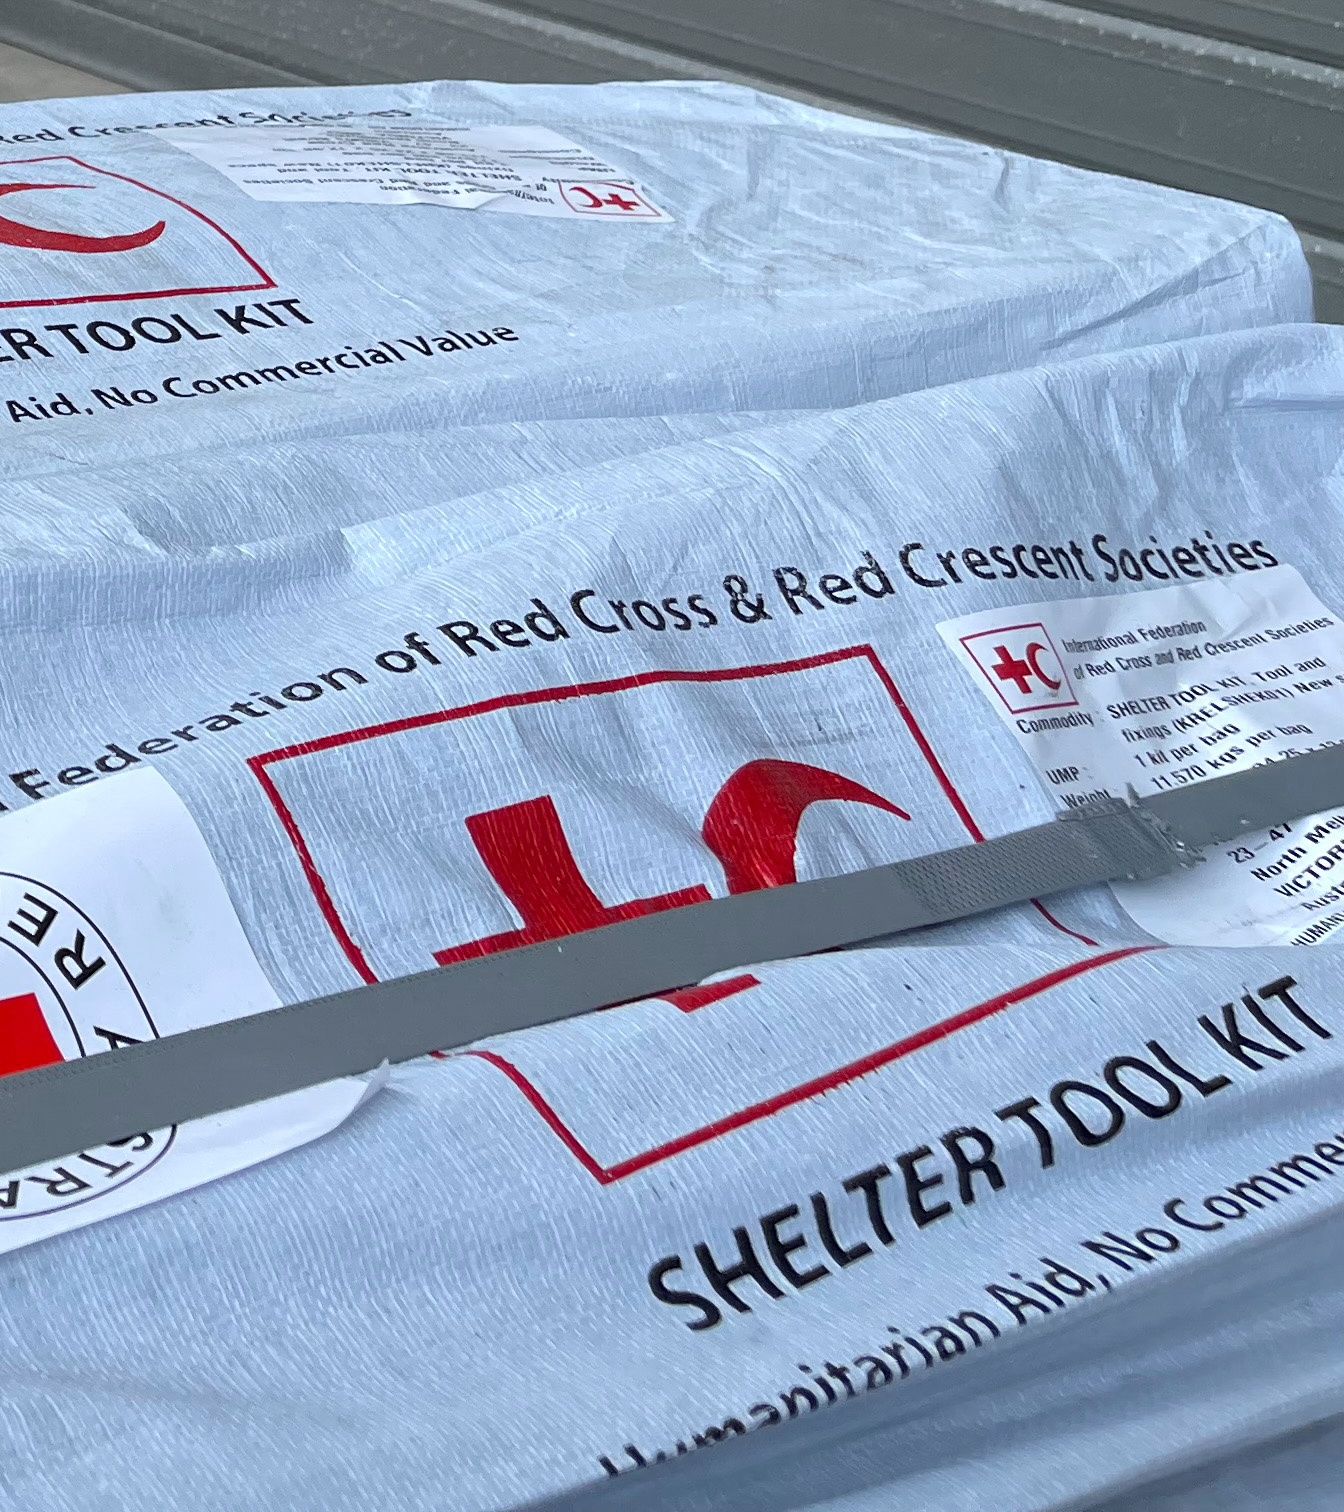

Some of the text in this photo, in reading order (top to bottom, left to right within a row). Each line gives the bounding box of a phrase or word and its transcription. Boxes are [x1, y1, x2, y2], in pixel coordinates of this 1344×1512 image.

[42, 312, 225, 358] TOOL
[214, 297, 314, 335] KIT
[6, 390, 93, 422] Aid,
[96, 379, 159, 411] No
[164, 342, 404, 399] Commercial
[408, 325, 519, 356] Value
[8, 660, 368, 801] Federation
[374, 631, 441, 675] of
[437, 599, 568, 657] Red
[569, 588, 718, 633] Cross
[721, 574, 770, 625] &
[771, 552, 894, 616] Red
[900, 537, 1092, 589] Crescent
[1092, 530, 1279, 582] Societies
[1061, 619, 1208, 654] International Federation
[1073, 615, 1335, 681] of Red Cross and Red Crescent Societies
[1016, 711, 1095, 735] Commodity
[1106, 693, 1172, 720] SHELTER
[1170, 677, 1220, 706] TOOL
[1251, 664, 1294, 683] Tool
[1294, 656, 1327, 673] and
[1122, 722, 1172, 743] fixings
[1293, 677, 1333, 694] New
[1045, 766, 1080, 786] UMP
[1147, 749, 1170, 767] kit
[1171, 743, 1200, 763] per
[1198, 723, 1242, 747] bag
[1206, 745, 1246, 771] kgs
[1245, 728, 1277, 749] per
[1275, 723, 1314, 736] bag
[1250, 844, 1308, 882] North
[648, 975, 1333, 1333] SHELTER TOOL KIT
[987, 1257, 1113, 1326] Aid,
[1079, 1226, 1181, 1272] No
[1163, 1133, 1344, 1233] Comme
